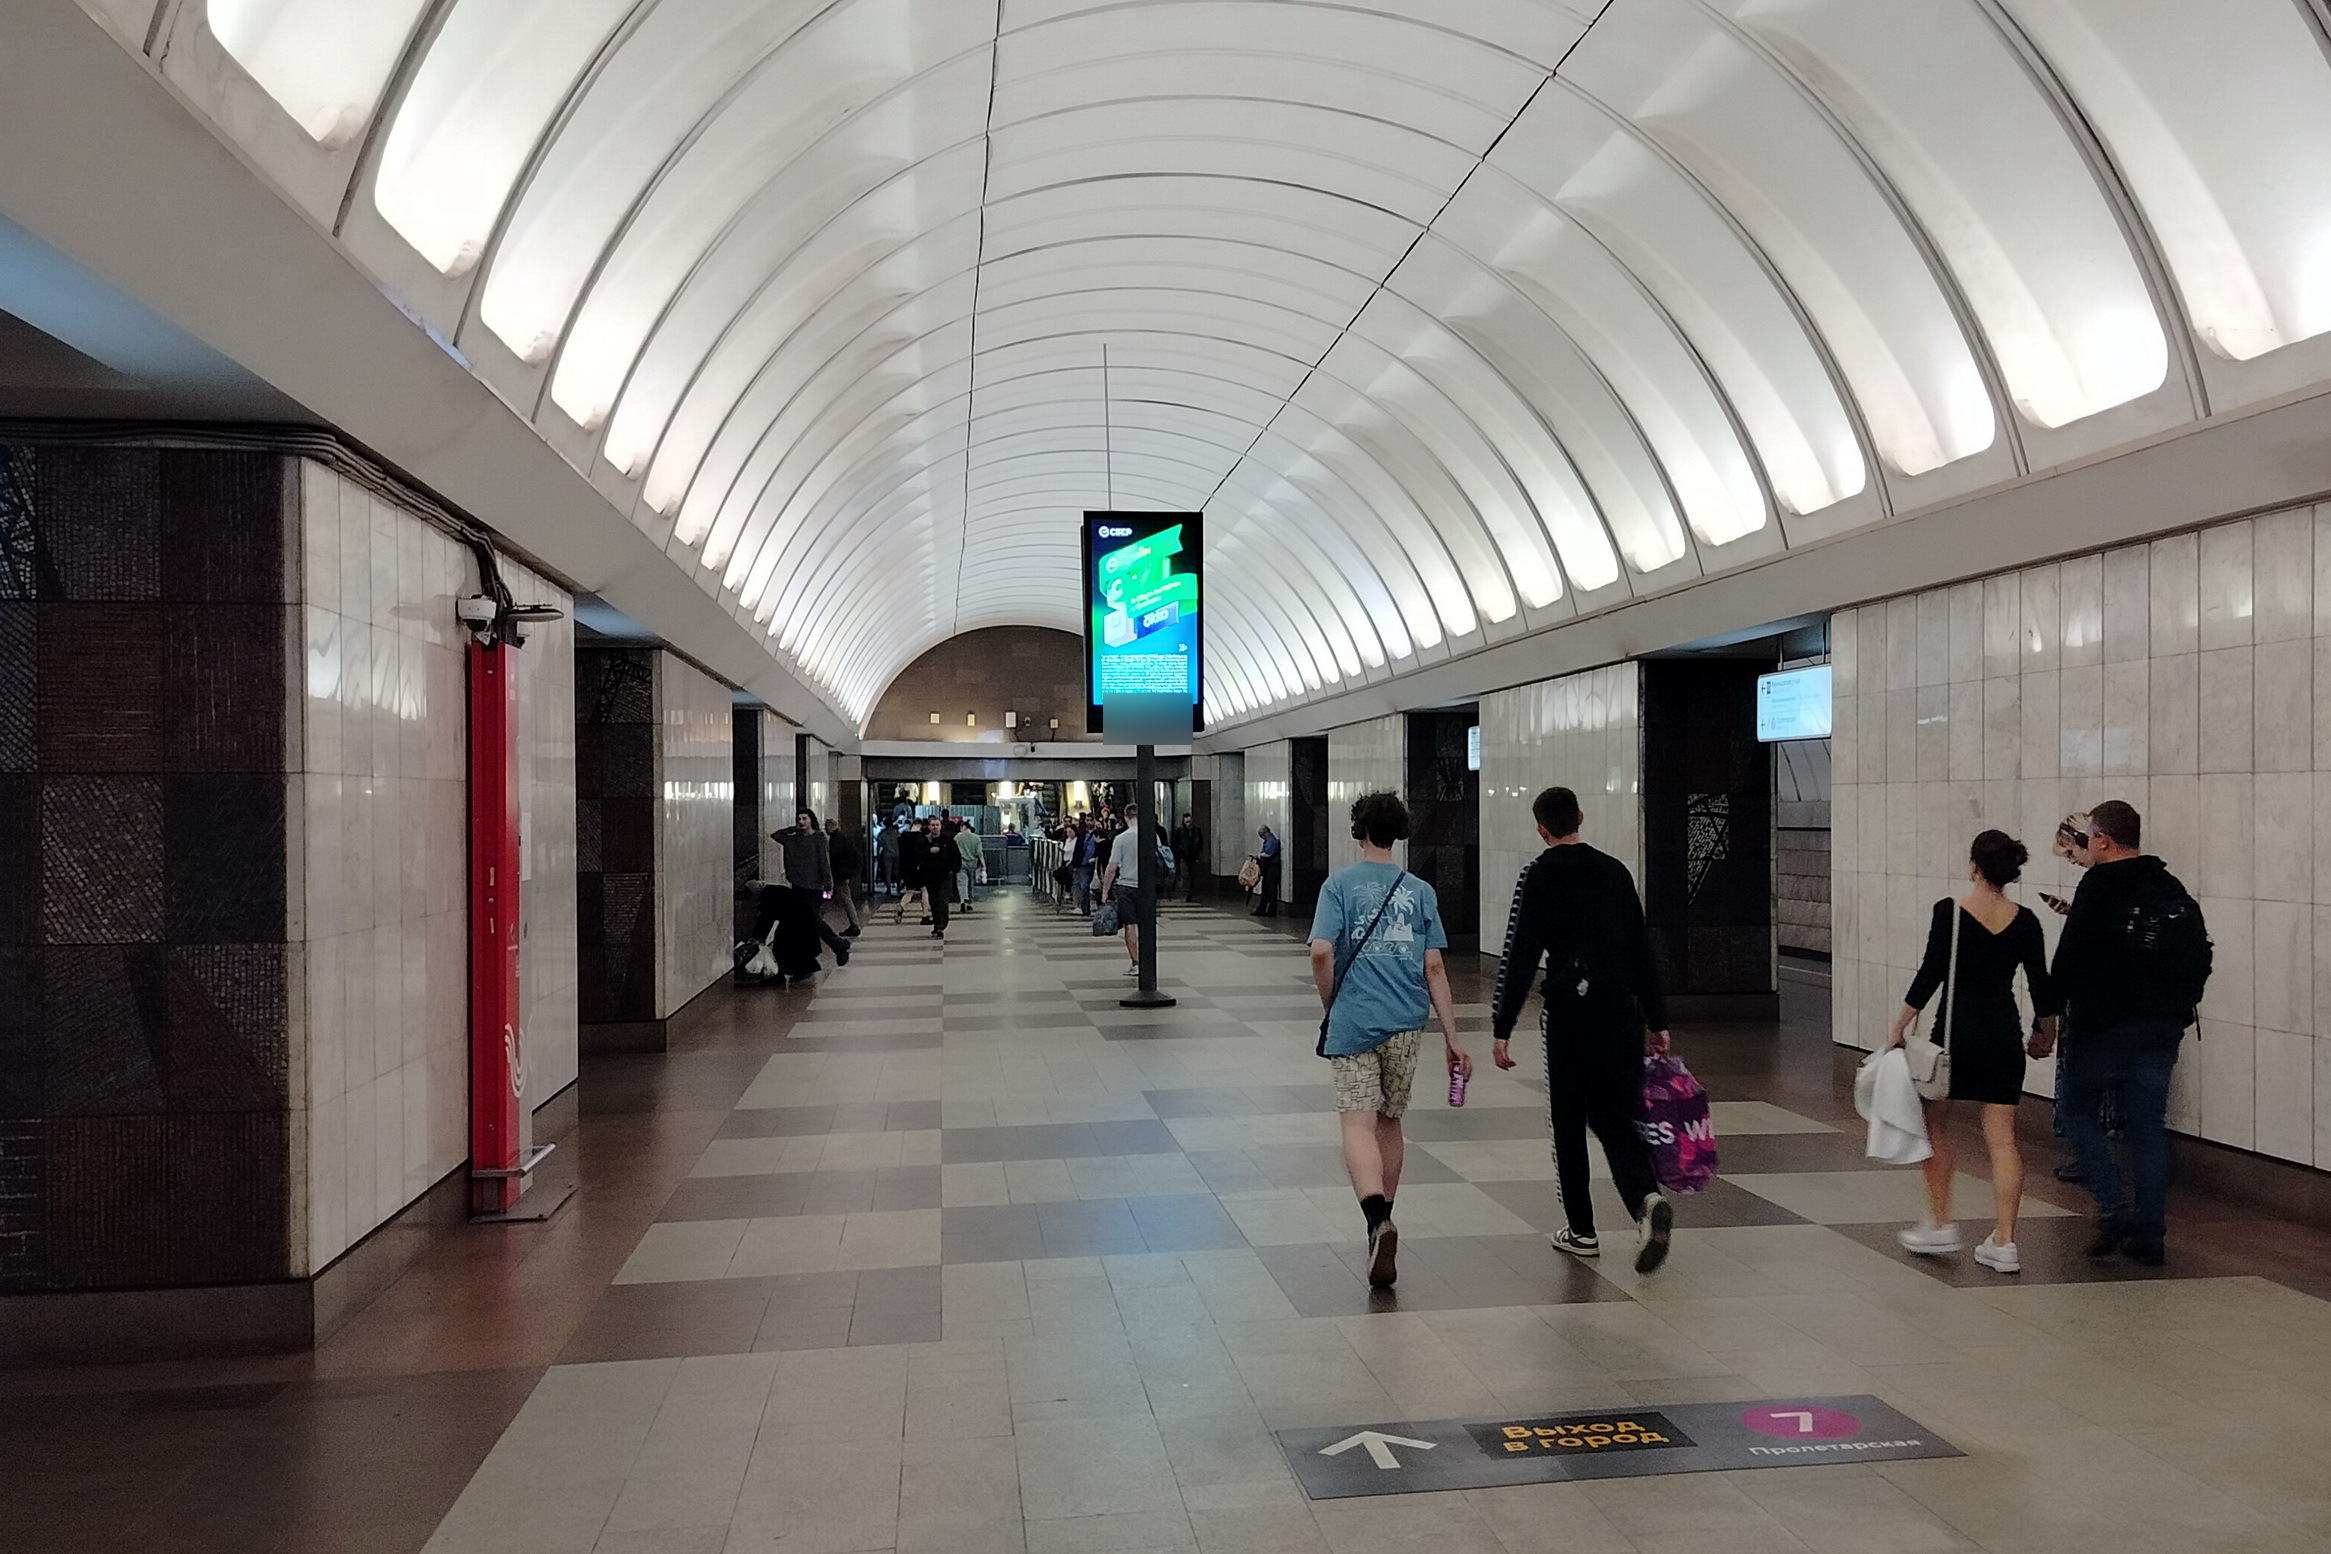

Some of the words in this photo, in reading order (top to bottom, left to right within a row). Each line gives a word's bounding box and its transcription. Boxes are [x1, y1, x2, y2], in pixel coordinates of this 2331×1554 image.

[1501, 1421, 1646, 1439] Выход
[1769, 1411, 1814, 1432] 7
[1502, 1441, 1529, 1452] в
[1538, 1431, 1670, 1449] город
[1748, 1438, 1923, 1456] Пролетарская
